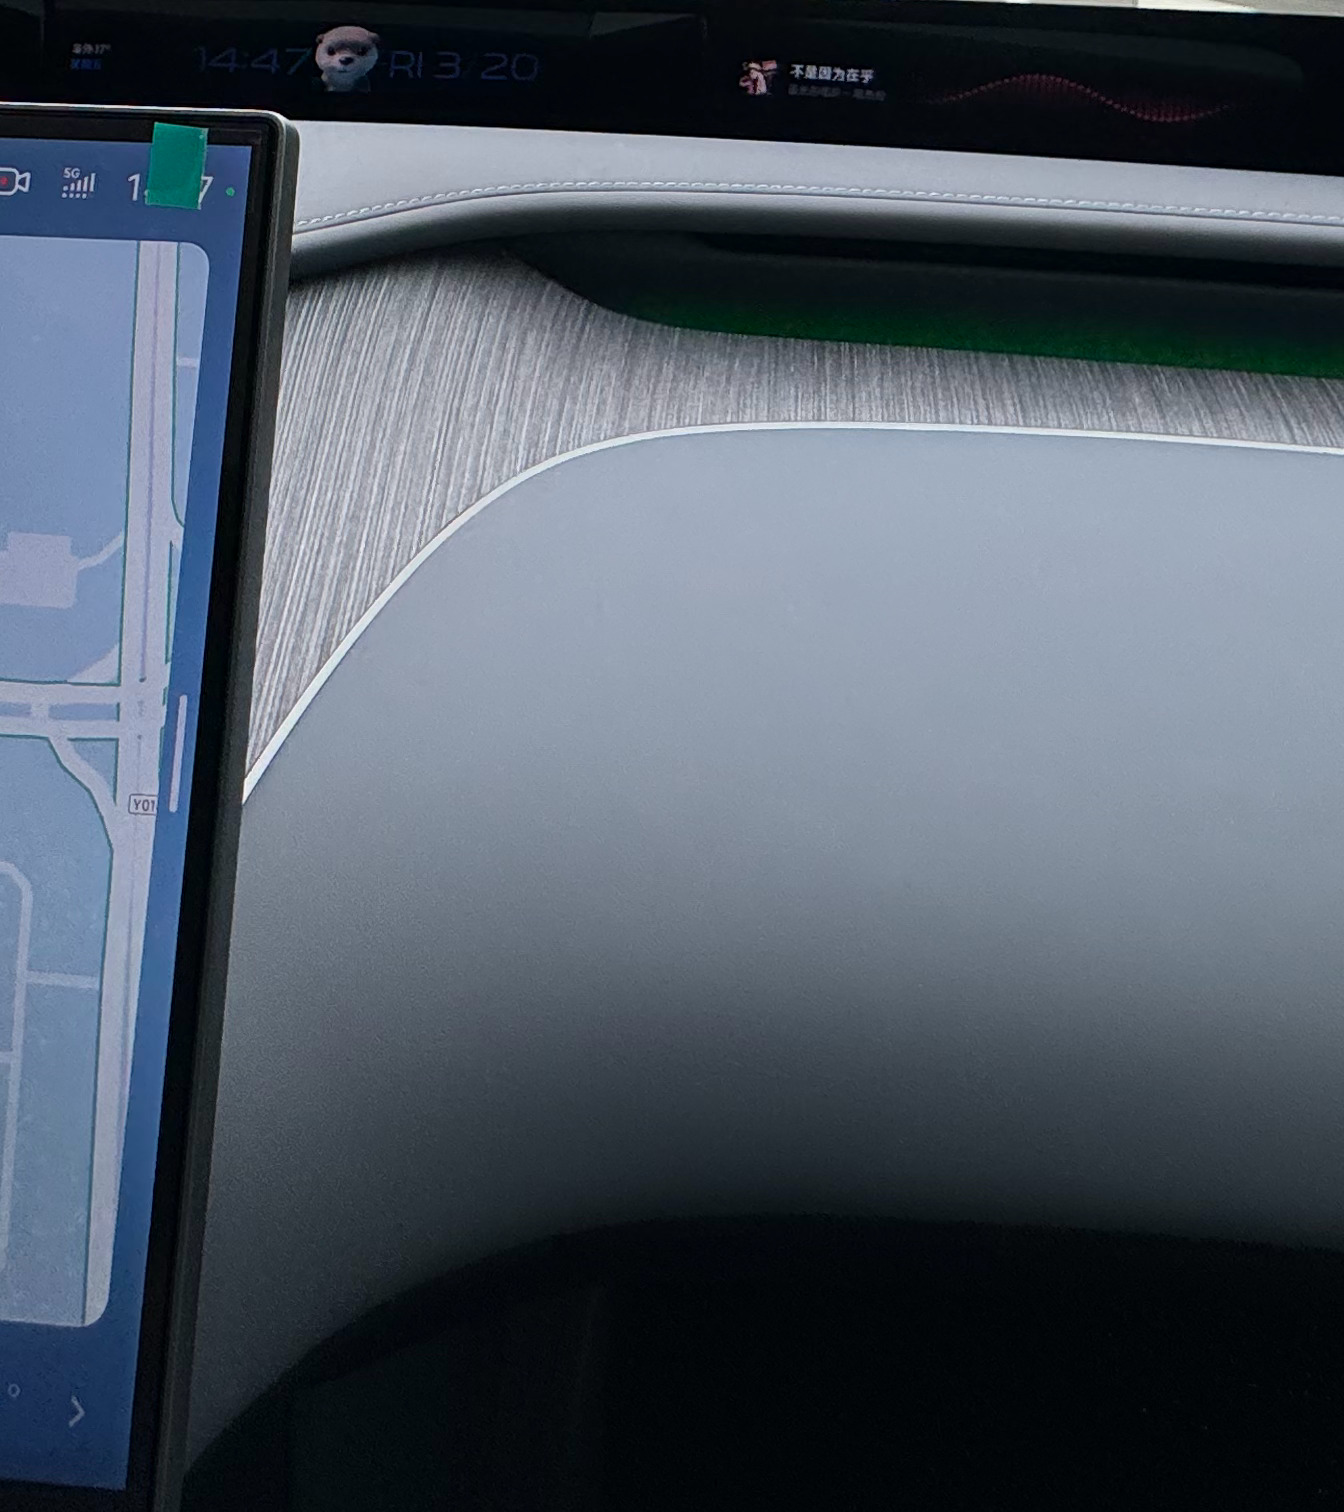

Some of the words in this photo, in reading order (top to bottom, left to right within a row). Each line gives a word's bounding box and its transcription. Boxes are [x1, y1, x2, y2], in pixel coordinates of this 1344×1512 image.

[198, 45, 312, 76] 14:47
[381, 50, 423, 80] RI
[63, 166, 81, 179] 5G
